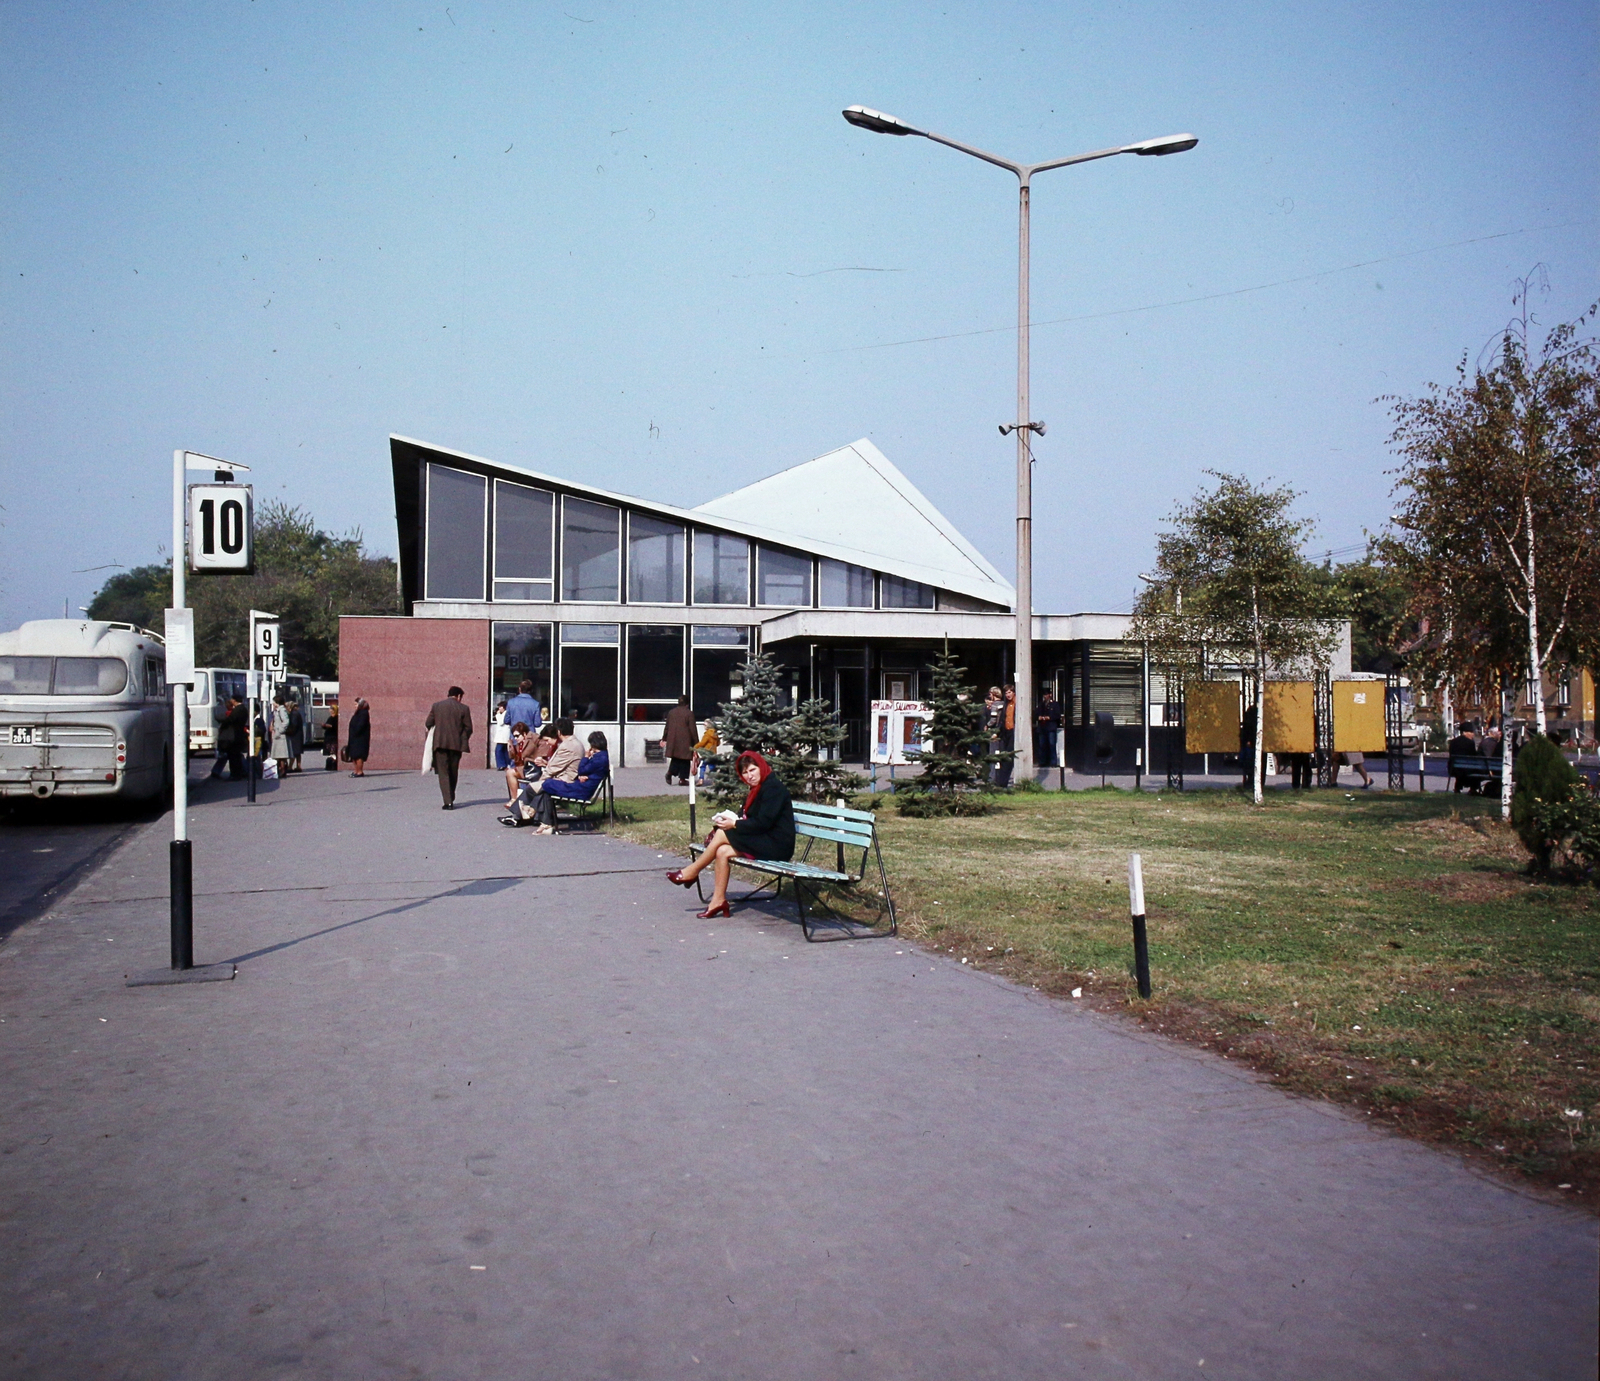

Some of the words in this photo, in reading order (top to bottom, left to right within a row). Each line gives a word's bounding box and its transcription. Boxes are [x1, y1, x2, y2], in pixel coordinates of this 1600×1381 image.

[199, 499, 243, 554] 10
[263, 629, 272, 650] 9
[272, 655, 280, 667] 8
[510, 656, 551, 667] BUF
